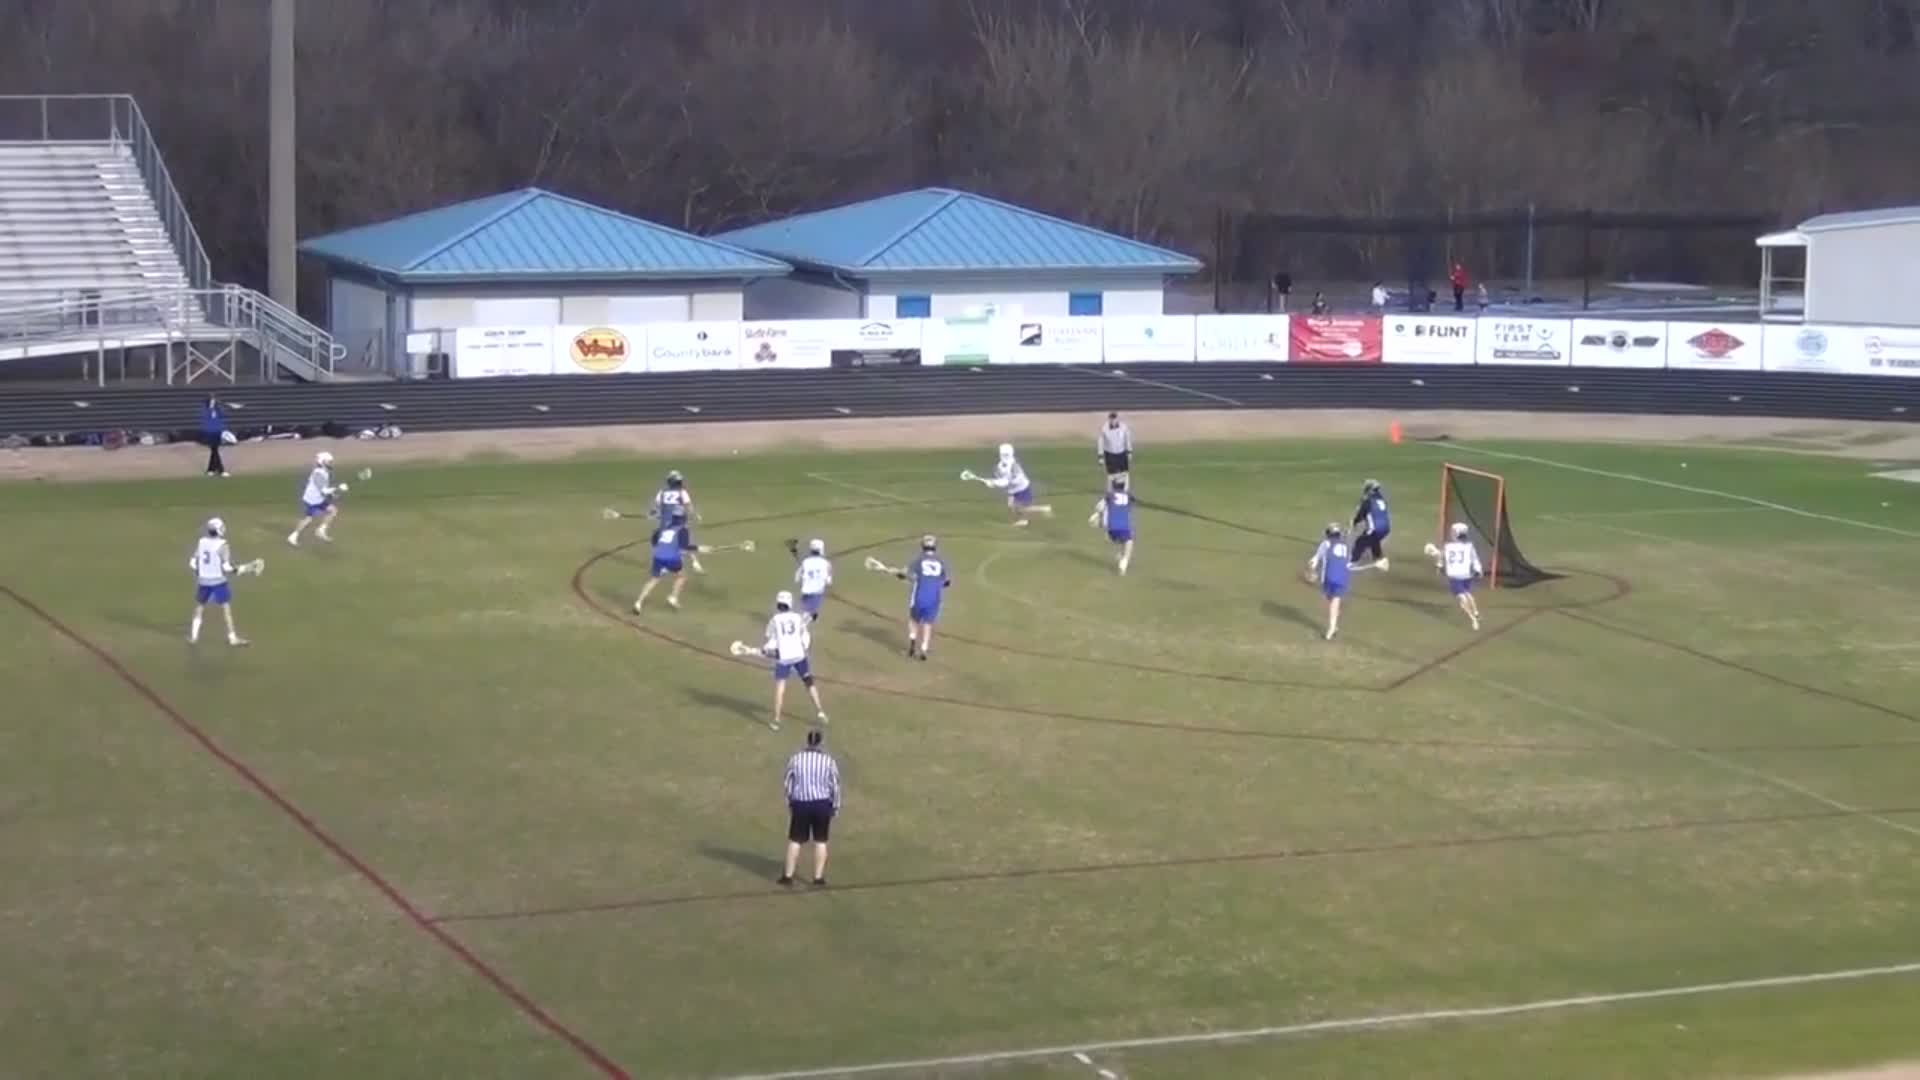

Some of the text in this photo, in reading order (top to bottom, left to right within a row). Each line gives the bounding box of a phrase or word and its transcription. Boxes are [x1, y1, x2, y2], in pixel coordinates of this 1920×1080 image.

[1429, 325, 1468, 338] FLINT
[1495, 324, 1533, 333] FIRST
[1496, 333, 1530, 343] TEAM
[780, 620, 796, 635] 13
